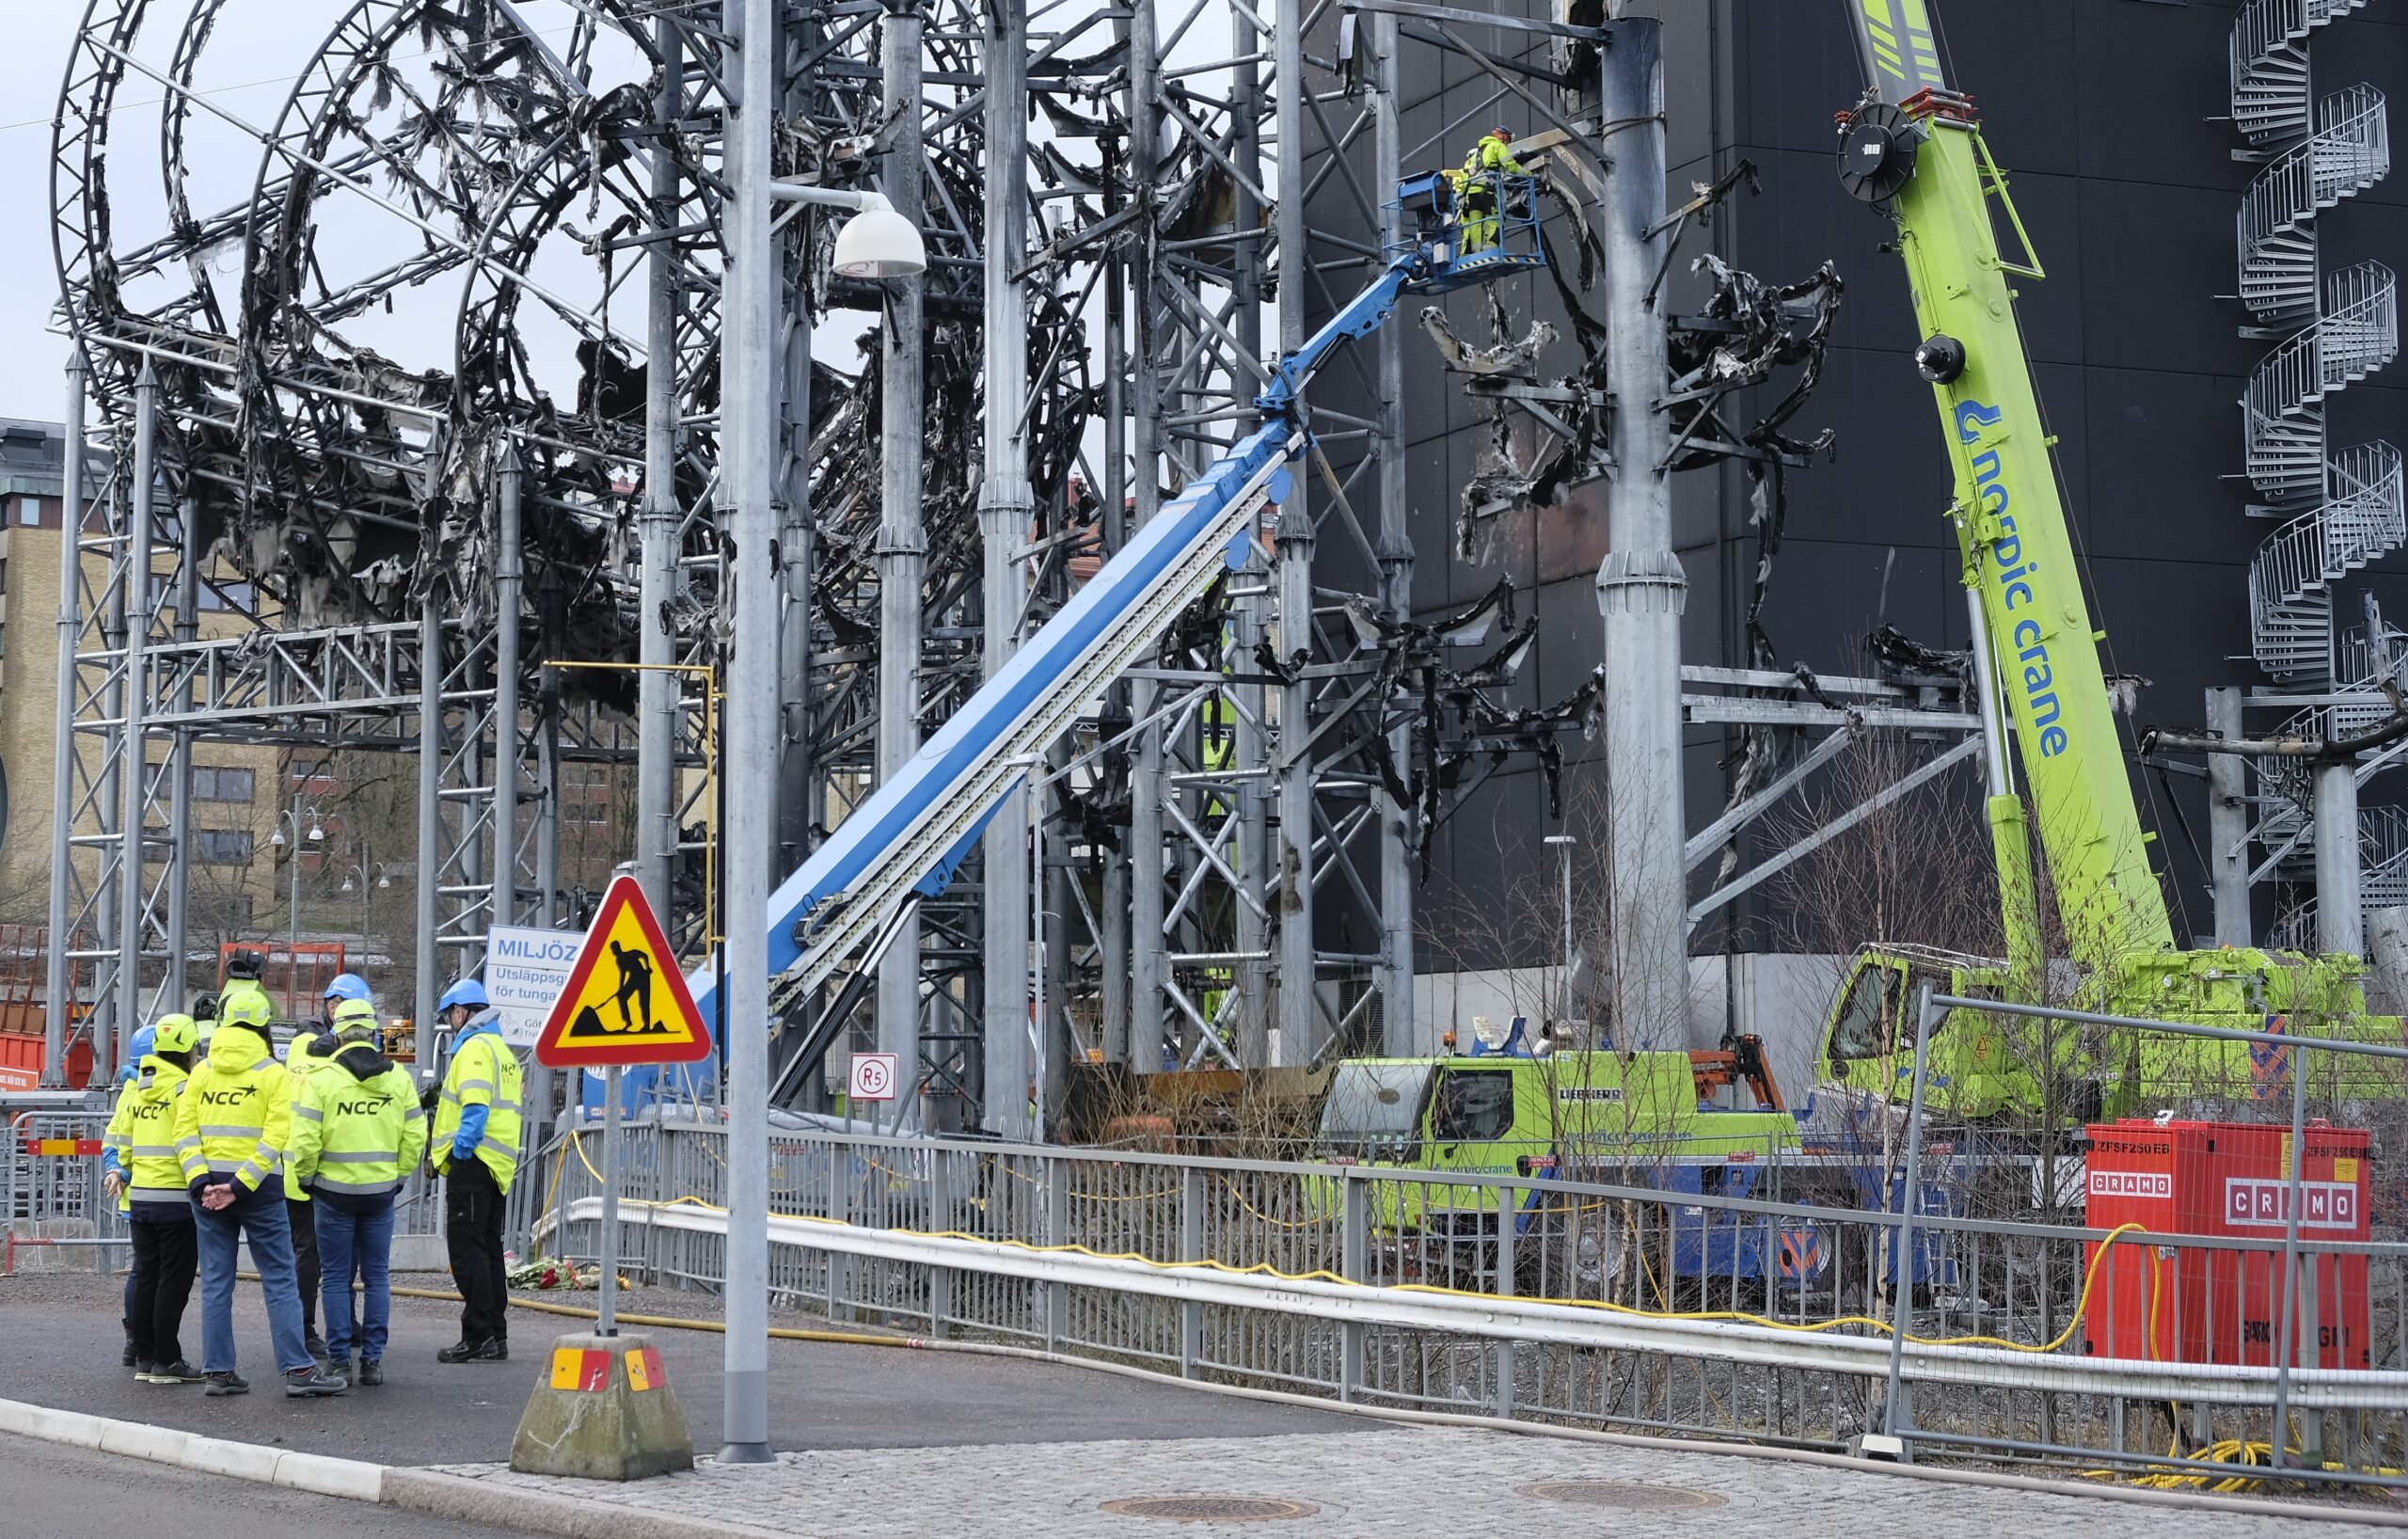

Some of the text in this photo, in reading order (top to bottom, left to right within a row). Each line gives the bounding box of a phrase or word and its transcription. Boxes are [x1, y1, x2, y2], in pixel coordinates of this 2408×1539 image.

[2014, 619, 2067, 758] crane
[498, 939, 578, 961] MILJÖZ
[495, 985, 557, 1003] för tunga
[524, 1019, 542, 1028] Göt
[863, 1067, 882, 1087] R5
[200, 1091, 243, 1105] NCC
[133, 1105, 159, 1120] NCC
[337, 1101, 380, 1116] NCC
[1483, 1165, 1513, 1174] crane
[2094, 1176, 2167, 1193] CRAMO
[2232, 1189, 2351, 1217] CRMO
